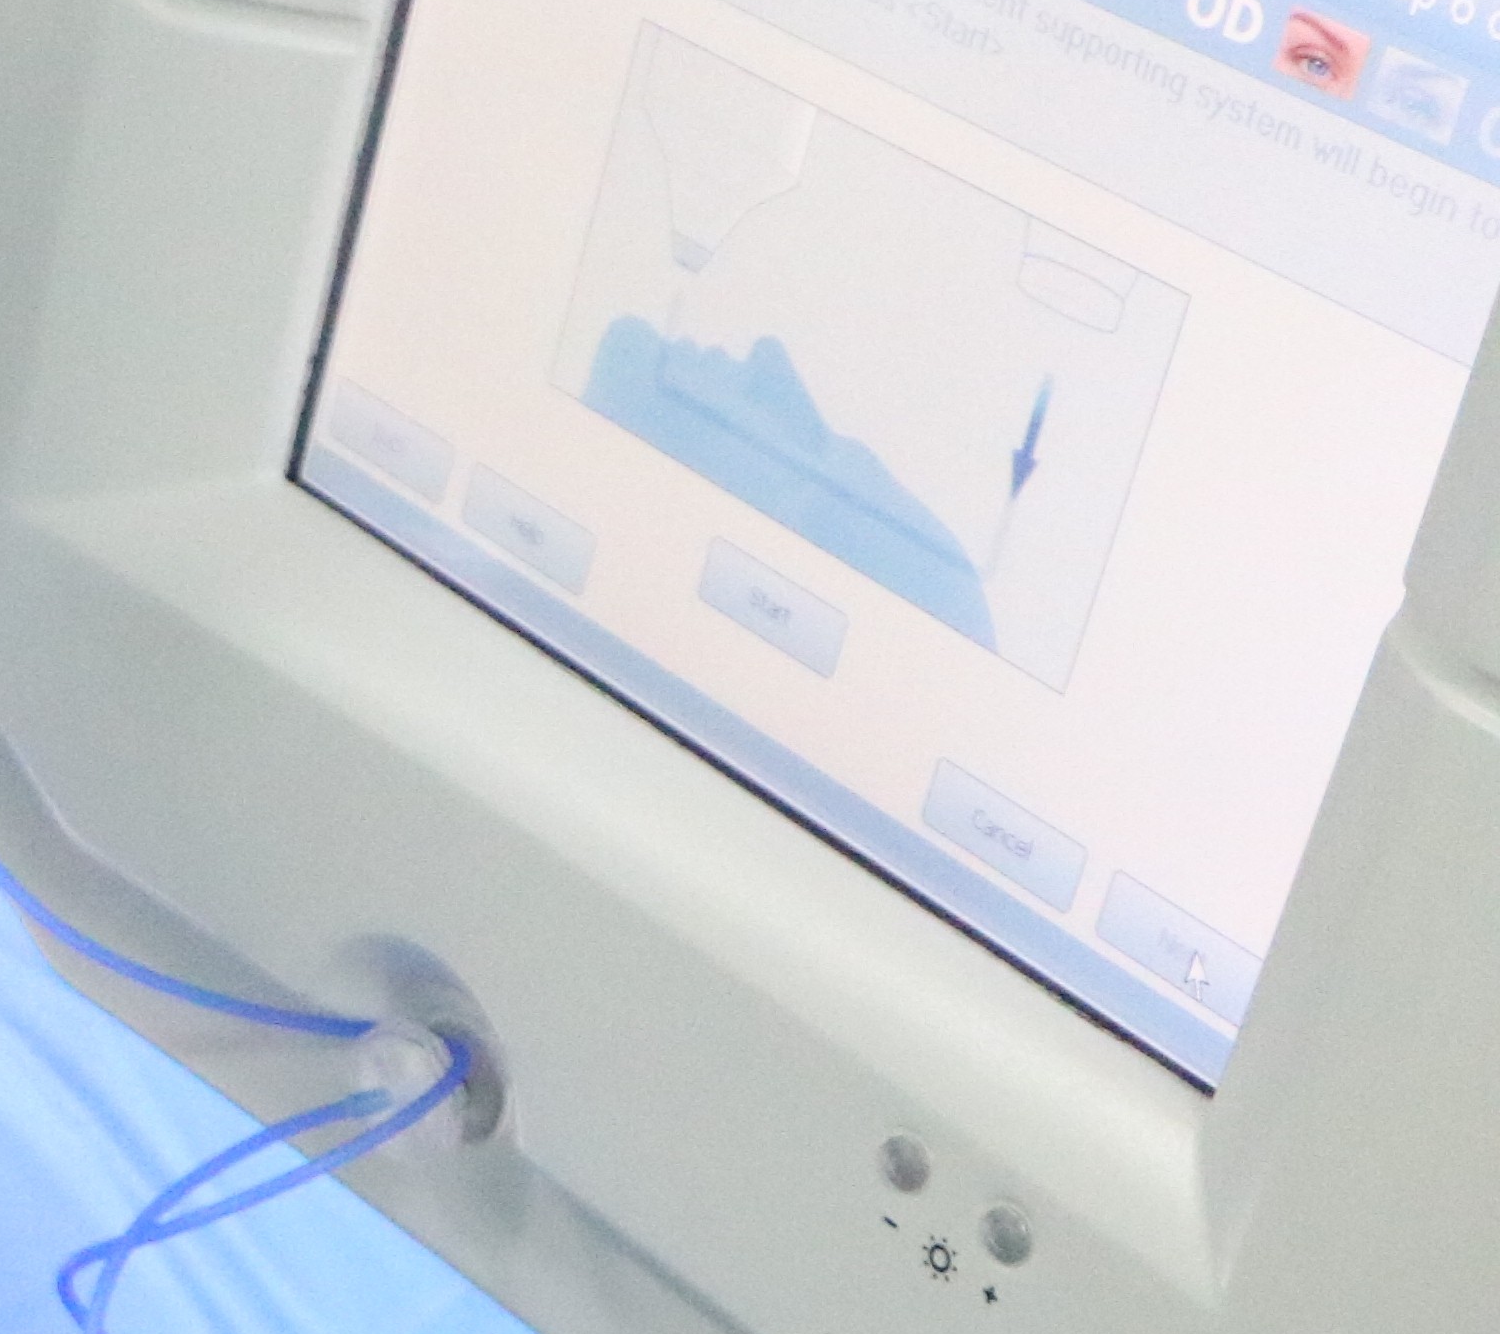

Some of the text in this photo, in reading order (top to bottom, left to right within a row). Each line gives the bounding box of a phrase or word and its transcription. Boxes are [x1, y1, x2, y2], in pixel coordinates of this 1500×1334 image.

[1036, 9, 1189, 104] supporting
[1196, 83, 1302, 151] system
[1312, 135, 1362, 176] will
[1367, 156, 1459, 223] begin
